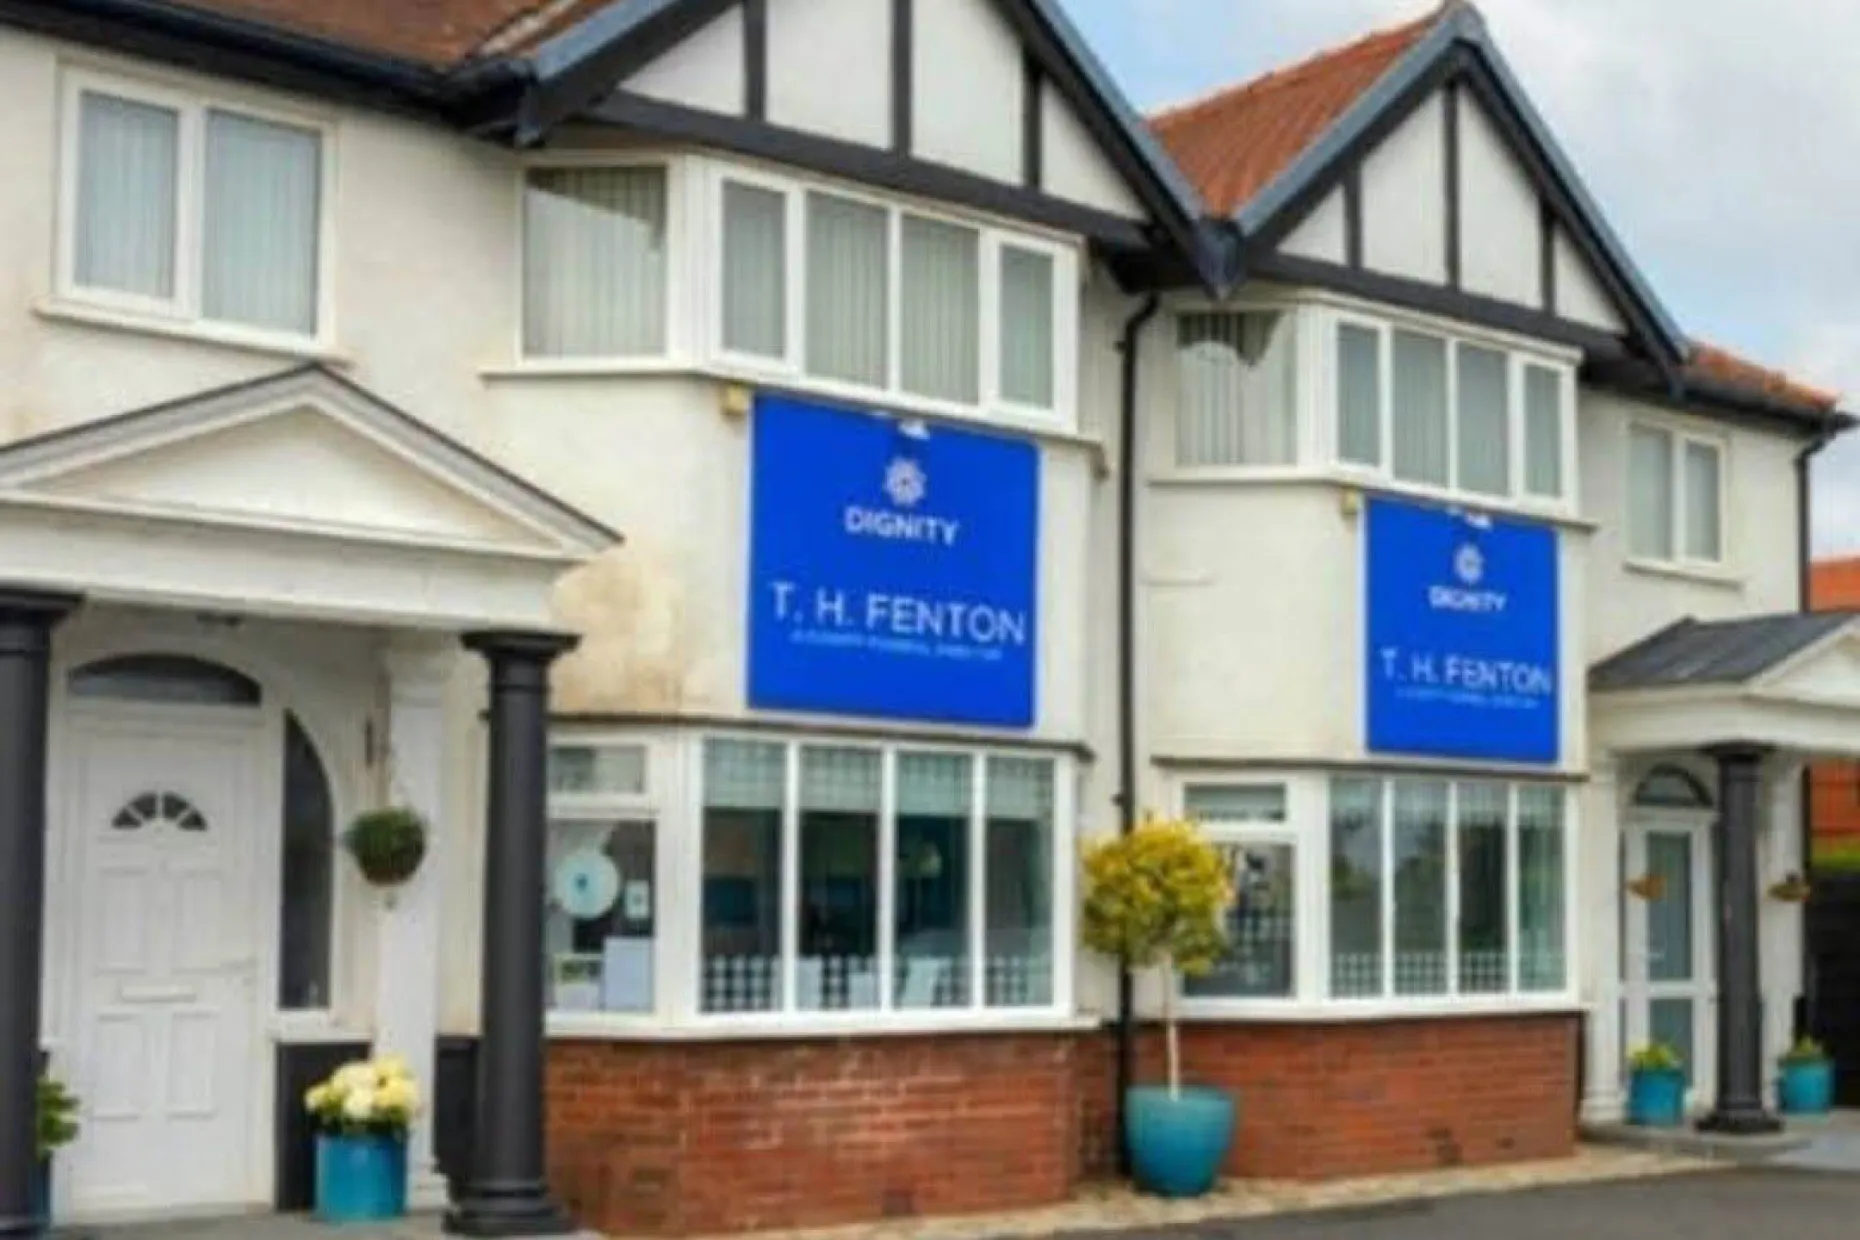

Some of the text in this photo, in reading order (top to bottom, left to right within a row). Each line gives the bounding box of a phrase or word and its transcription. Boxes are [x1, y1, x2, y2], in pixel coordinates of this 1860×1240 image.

[845, 506, 960, 546] DIGNITY
[770, 580, 804, 624] T.
[866, 592, 1027, 645] FENTON
[1444, 654, 1554, 697] FENTON
